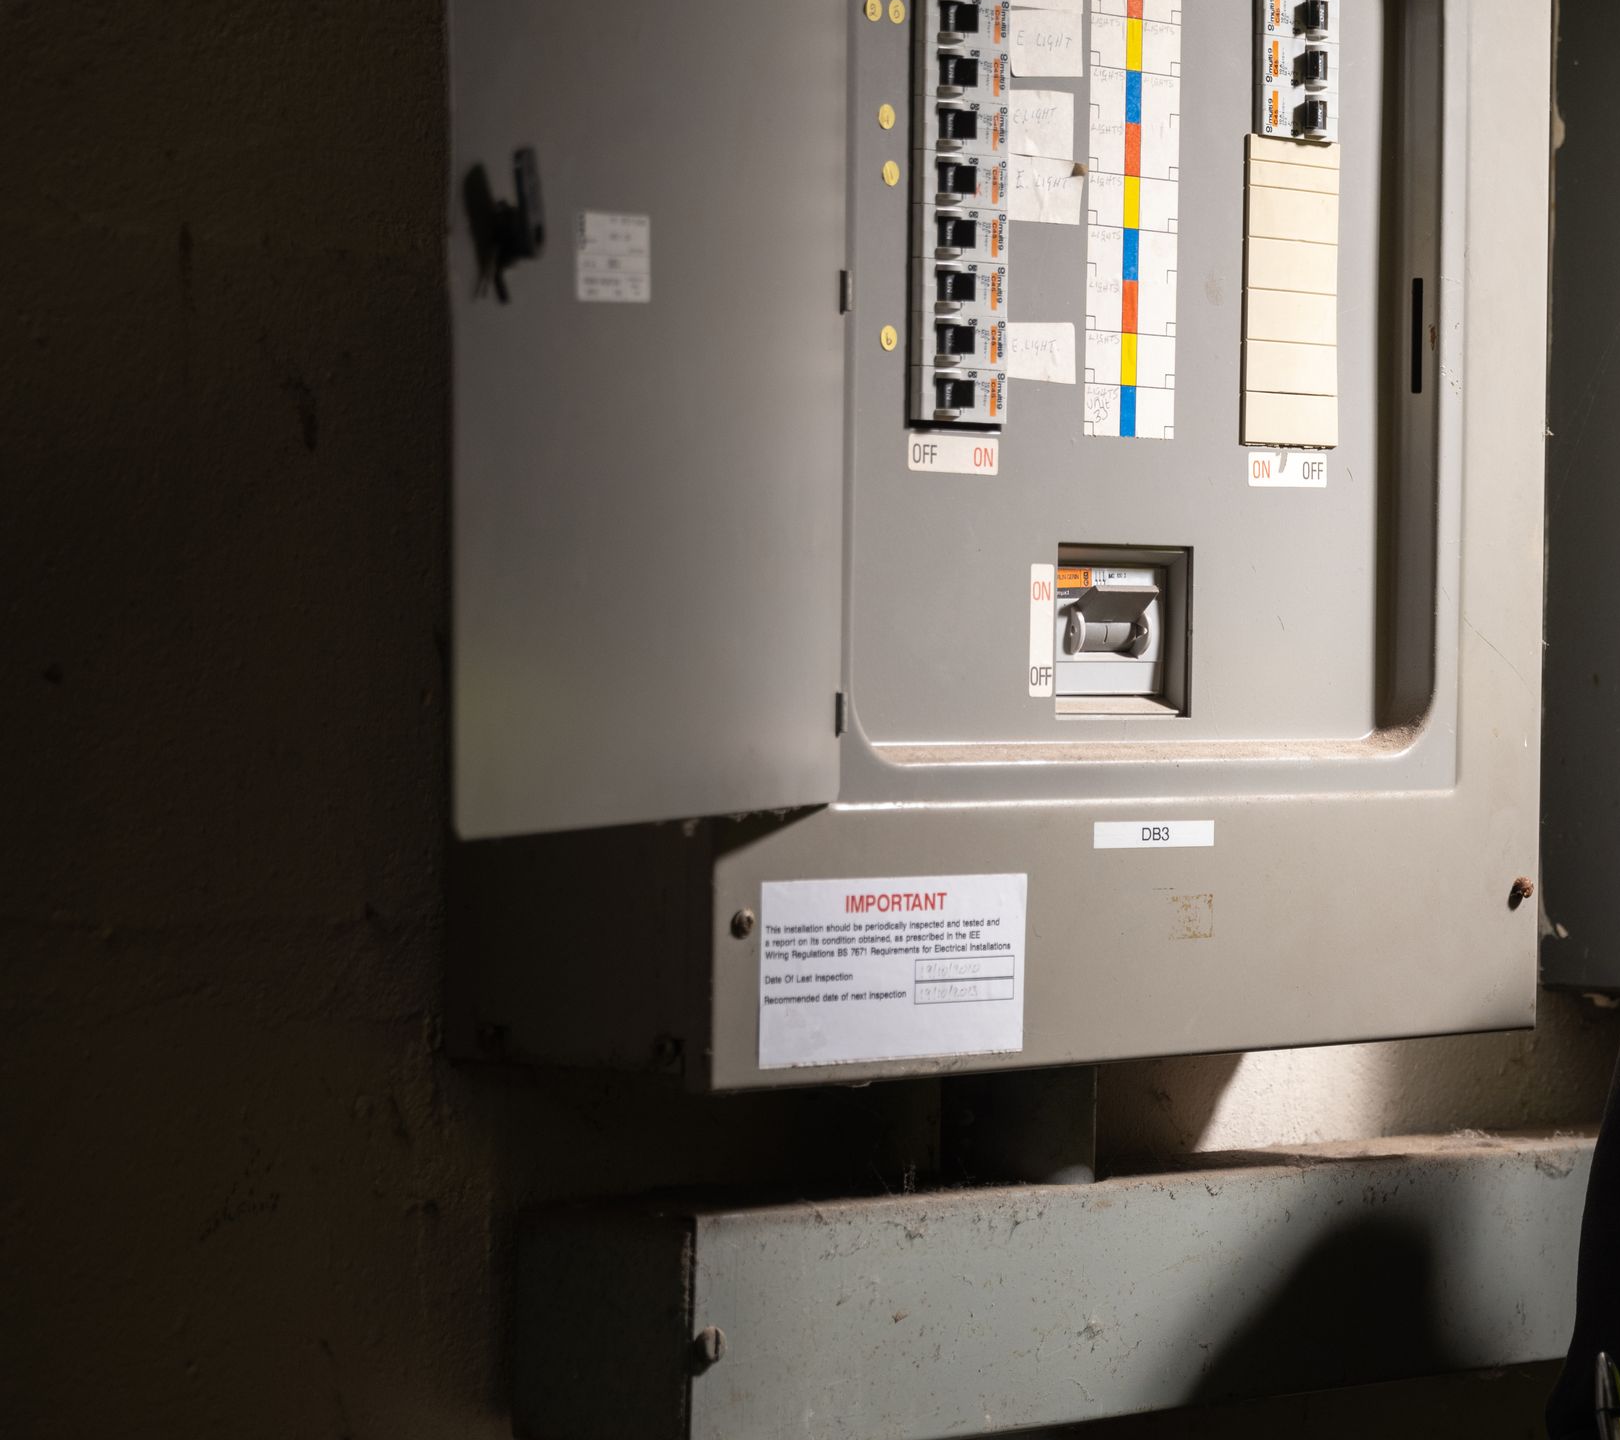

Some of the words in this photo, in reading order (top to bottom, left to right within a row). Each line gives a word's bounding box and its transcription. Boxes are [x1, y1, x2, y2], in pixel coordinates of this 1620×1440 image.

[1036, 33, 1072, 51] LIGHT
[912, 443, 938, 465] OFF
[973, 447, 994, 468] ON
[1252, 458, 1271, 479] ON
[1302, 460, 1324, 480] OFF
[1033, 581, 1051, 601] ON
[1030, 666, 1052, 686] OFF
[1141, 827, 1170, 841] DB3
[845, 892, 947, 913] IMPORTANT
[766, 925, 781, 934] This
[784, 924, 824, 934] installation
[826, 923, 850, 933] should
[853, 923, 863, 931] be
[865, 921, 907, 933] periodically
[909, 919, 944, 931] inspected
[946, 919, 960, 928] and
[962, 918, 984, 927] tested
[986, 918, 1000, 926] and
[772, 938, 796, 948] report
[810, 937, 819, 946] its
[821, 936, 856, 945] condition
[906, 932, 944, 943] prescribed
[947, 931, 953, 939] in
[955, 931, 966, 939] the
[969, 931, 981, 939] IEE
[766, 950, 789, 961] Wiring
[792, 949, 835, 960] Regulations
[837, 948, 848, 957] BS
[851, 947, 867, 956] 7671
[870, 945, 920, 957] Requirements
[922, 945, 932, 953] for
[934, 943, 967, 953] Electrical
[765, 975, 782, 985] Date
[785, 974, 794, 983] Of
[796, 974, 813, 983] Last
[764, 994, 820, 1005] Recommended
[822, 992, 839, 1002] date
[841, 992, 849, 1001] of
[851, 991, 867, 1000] next
